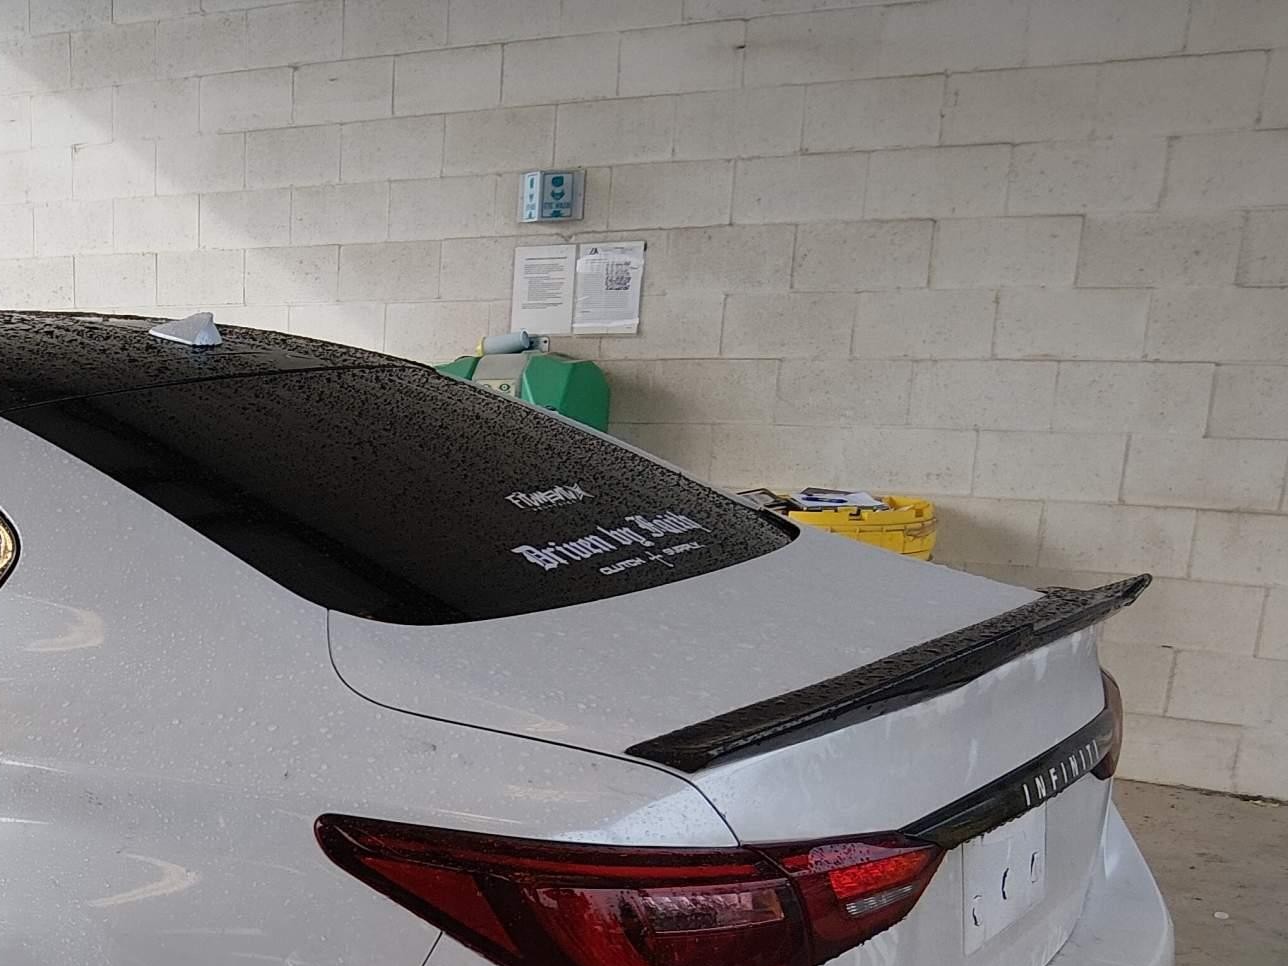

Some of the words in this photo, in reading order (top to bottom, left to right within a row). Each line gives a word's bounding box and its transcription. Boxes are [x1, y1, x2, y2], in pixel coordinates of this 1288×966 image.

[597, 526, 655, 547] by
[624, 511, 712, 537] Faith
[512, 534, 617, 571] Driven
[1022, 739, 1100, 806] INFINITI
